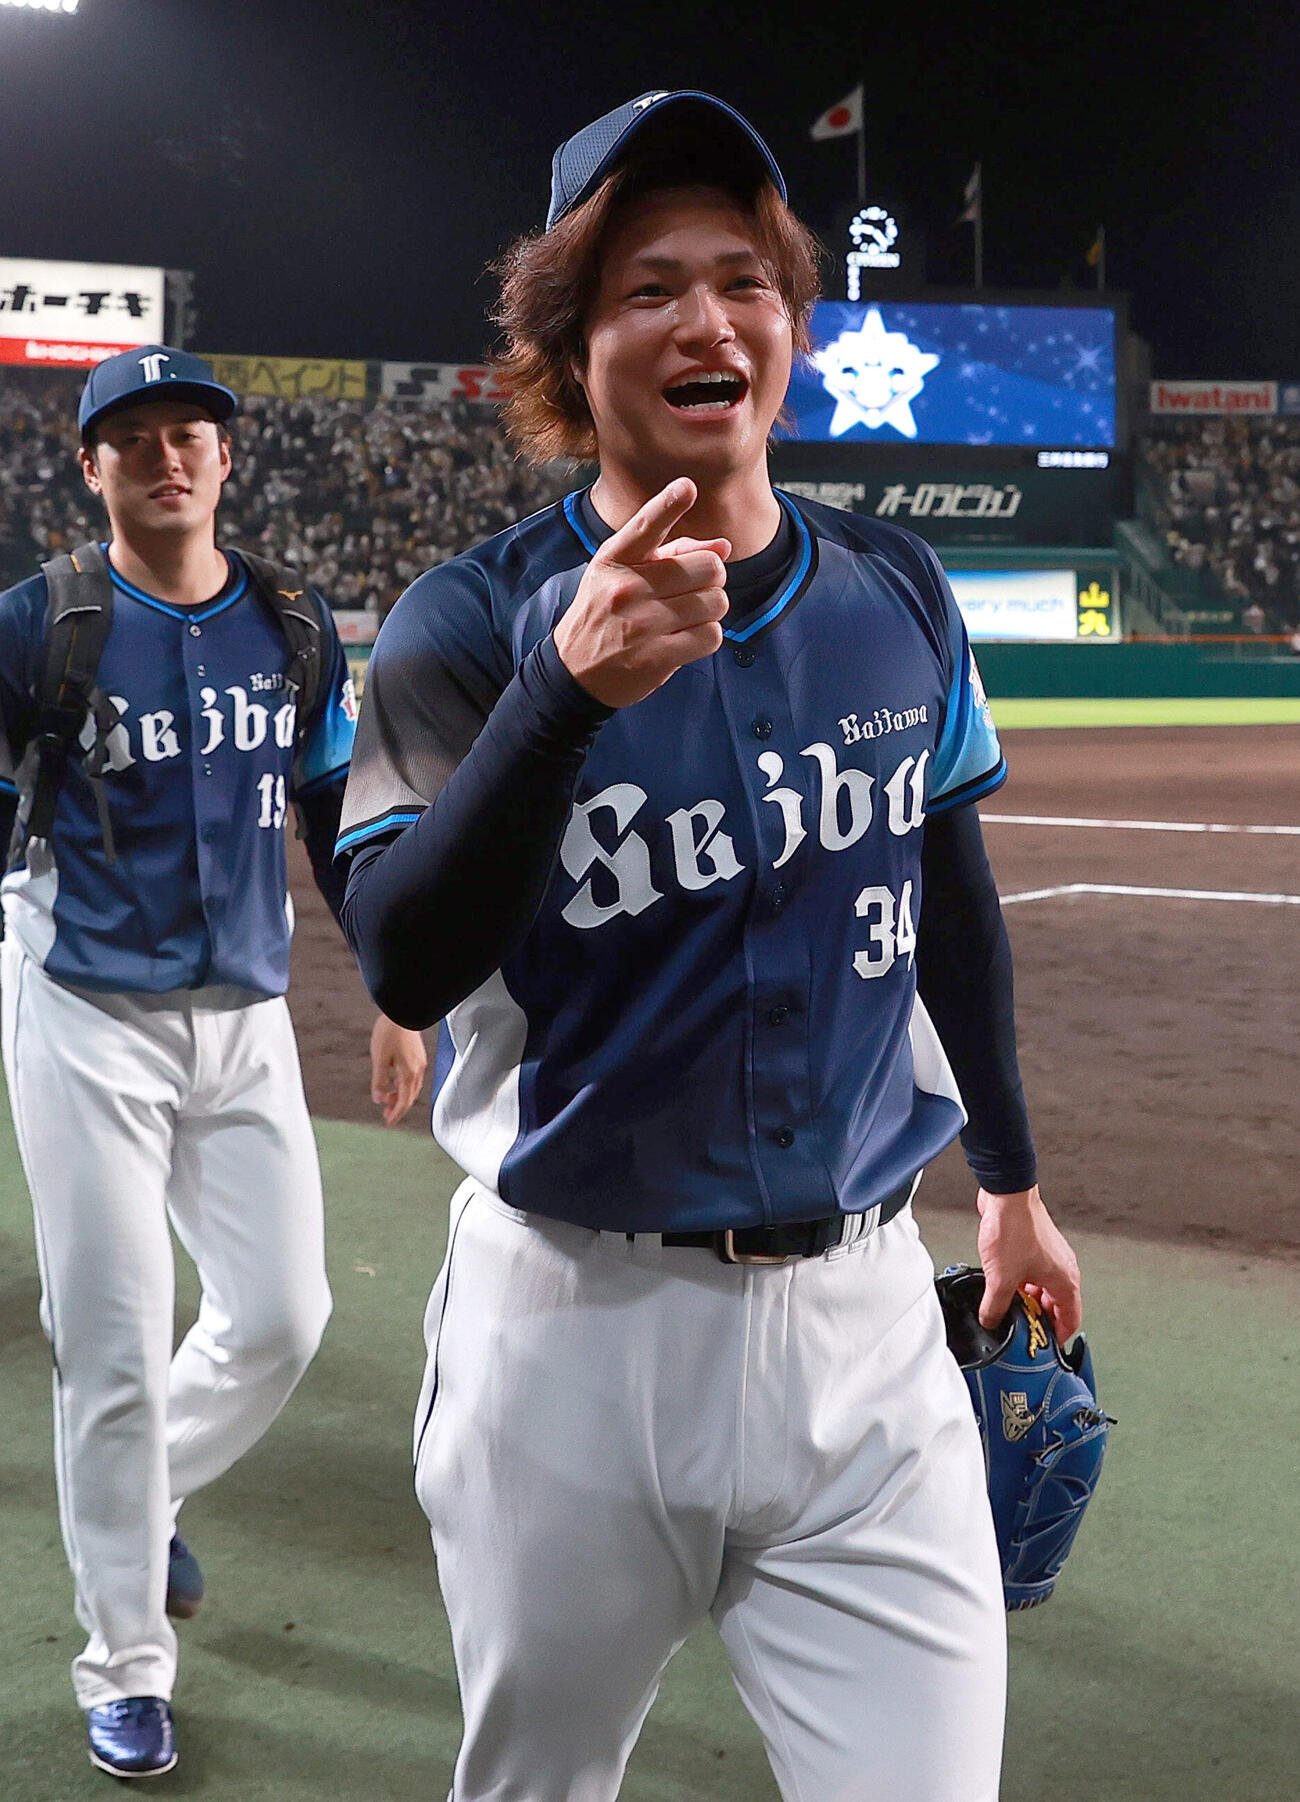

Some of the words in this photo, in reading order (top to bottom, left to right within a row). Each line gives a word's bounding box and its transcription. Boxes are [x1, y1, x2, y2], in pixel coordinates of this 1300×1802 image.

[1157, 386, 1271, 409] Iwatani
[838, 704, 928, 745] Saitama
[560, 742, 931, 929] Seibu
[852, 880, 917, 979] 34
